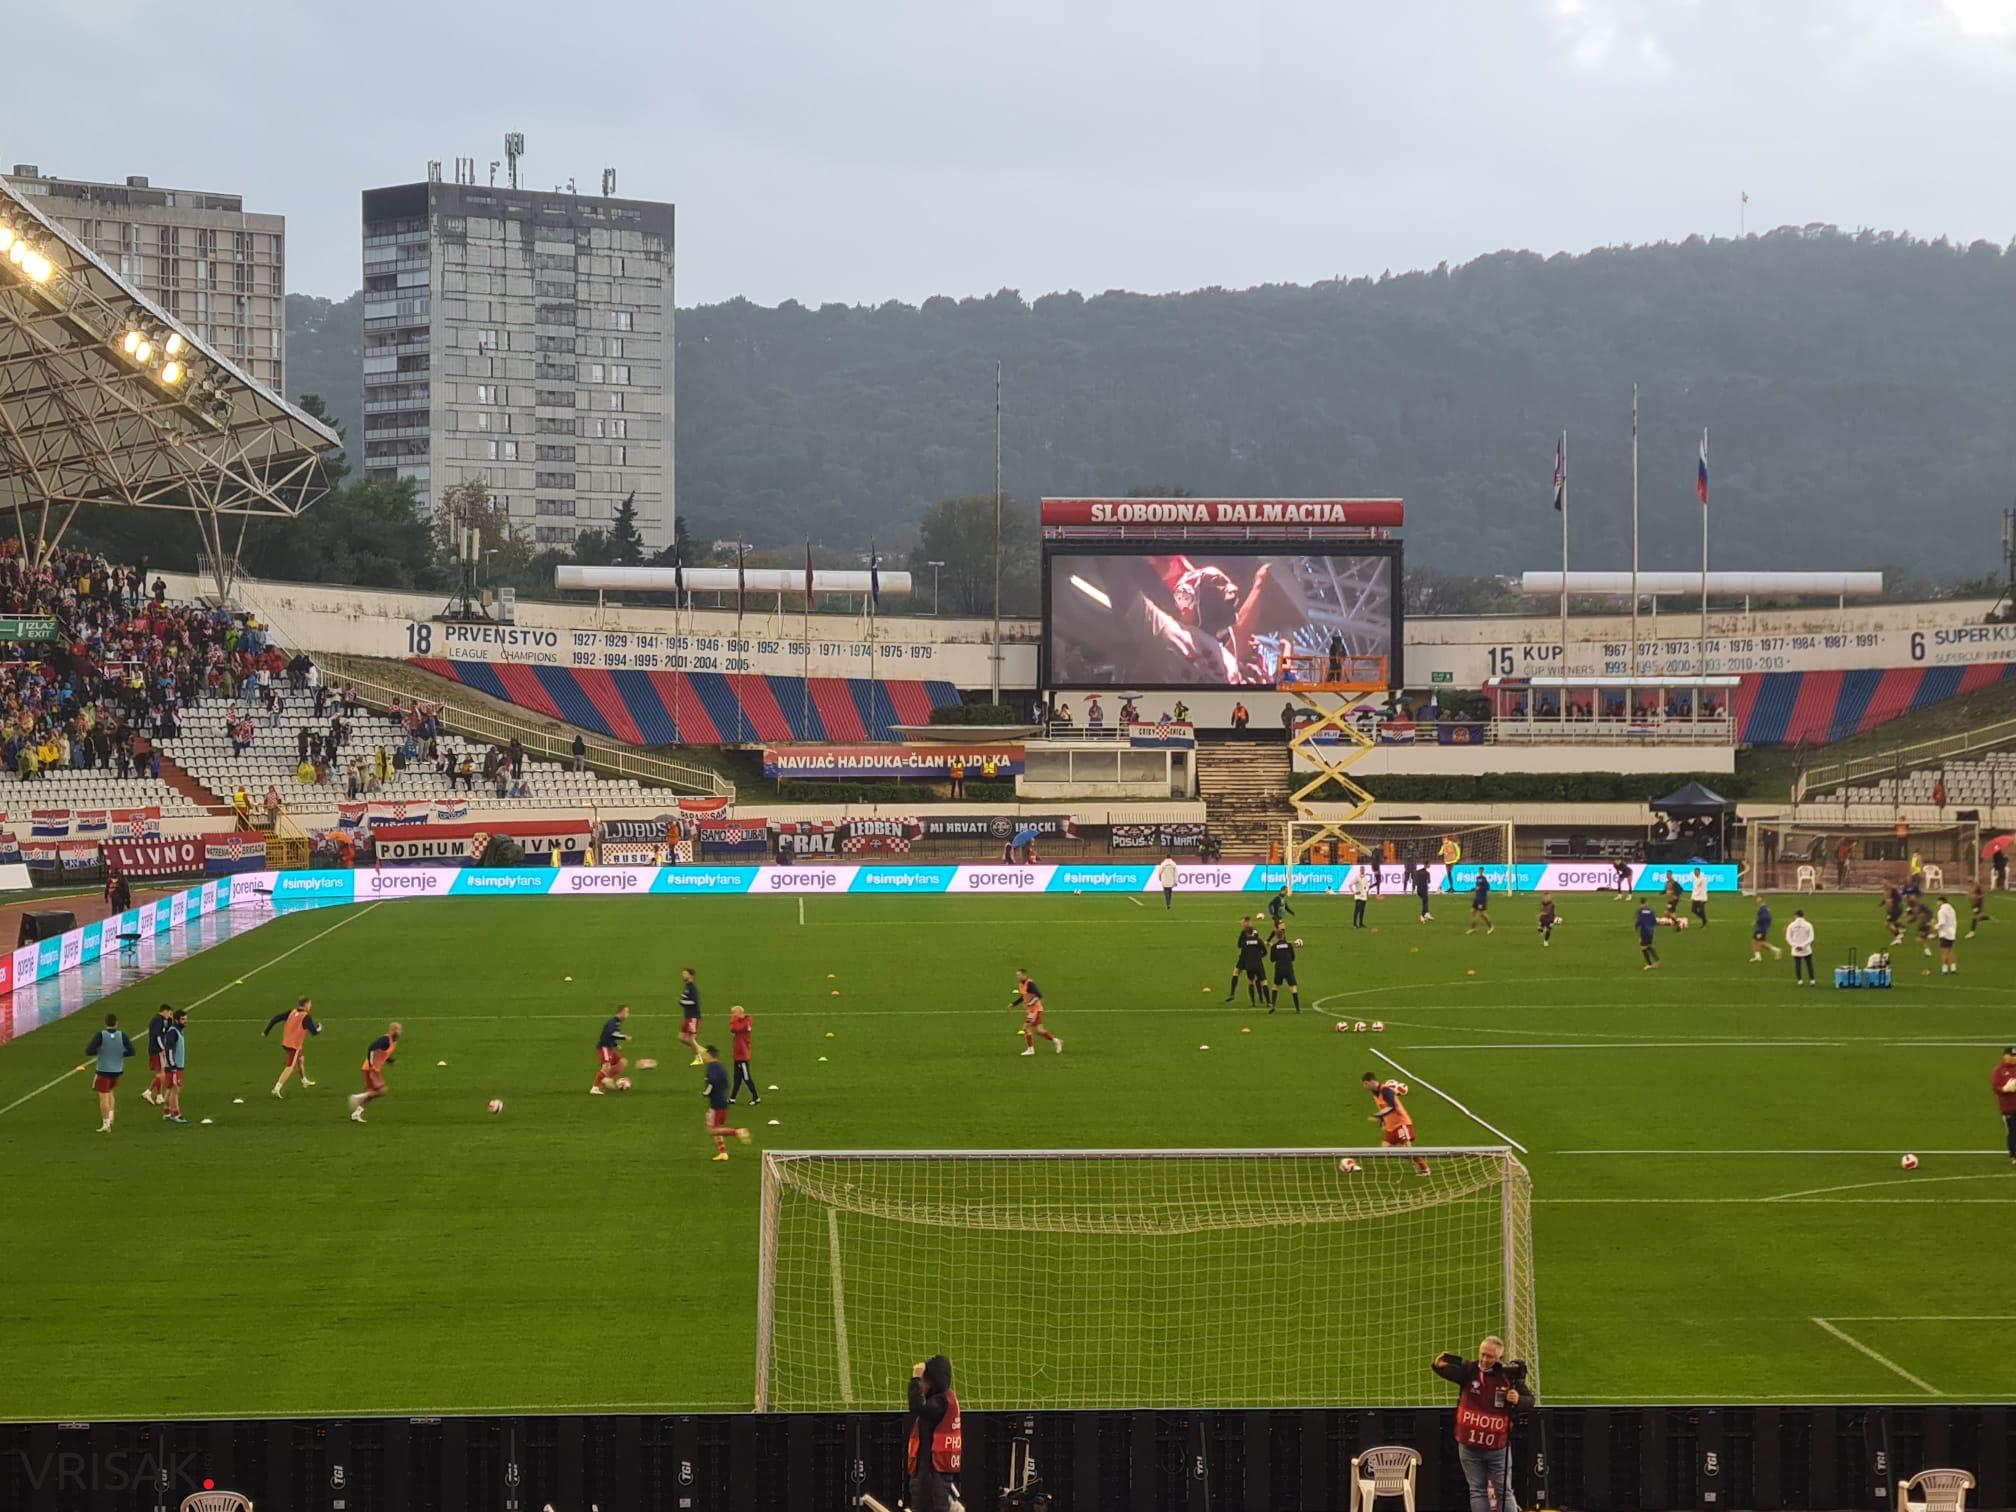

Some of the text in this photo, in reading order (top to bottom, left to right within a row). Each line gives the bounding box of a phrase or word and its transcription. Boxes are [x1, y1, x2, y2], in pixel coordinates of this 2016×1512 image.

[1091, 504, 1346, 522] SLOBODNA DALMACIJA
[26, 622, 55, 630] IZLAZ
[28, 630, 51, 638] EXIT
[406, 623, 432, 655] 18
[445, 626, 557, 647] PRVENSTVO
[1604, 643, 1627, 656] 1967
[1666, 641, 1690, 654] 1973
[1761, 638, 1784, 650] 1977
[1792, 636, 1816, 649] 1984
[1824, 635, 1847, 647] 1987
[1856, 634, 1878, 646] 1991
[574, 633, 597, 647] 1927
[605, 634, 627, 648] 1929
[637, 635, 658, 649] 1941
[696, 638, 719, 652] 1946
[757, 641, 779, 654] 1952
[819, 643, 841, 656] 1971
[880, 645, 903, 658] 1975
[911, 646, 932, 659] 1979
[1524, 645, 1563, 660] KUP
[1911, 631, 1925, 661] 6
[449, 648, 557, 663] LEAGUE CHAMPIONS
[573, 651, 596, 665] 1992
[604, 653, 626, 666] 1994
[634, 654, 657, 667] 1995
[665, 655, 688, 668] 2001
[694, 656, 718, 669] 2004
[1488, 647, 1514, 676] 15
[1604, 662, 1627, 674] 1993
[778, 752, 835, 769] NAVIJAČ
[702, 829, 726, 841] SAMO
[850, 821, 902, 837] LEOBEN
[930, 822, 943, 833] MI
[946, 822, 987, 833] HRVATI
[119, 843, 194, 865] LIVNO
[381, 837, 577, 858] PODHUM IVNO
[283, 876, 344, 891] #simplyfans
[371, 874, 437, 892] gorenje
[467, 871, 542, 887] #simplyfans
[571, 871, 637, 890] gorenje
[667, 872, 741, 887] #simplyfans
[771, 870, 837, 889] gorenje
[866, 872, 940, 887] #simplyfans
[969, 870, 1034, 889] gorenje
[1064, 871, 1137, 886] #simplyfans
[1177, 869, 1231, 887] orenje
[1463, 1411, 1504, 1430] PHOTO
[1468, 1429, 1495, 1446] 110
